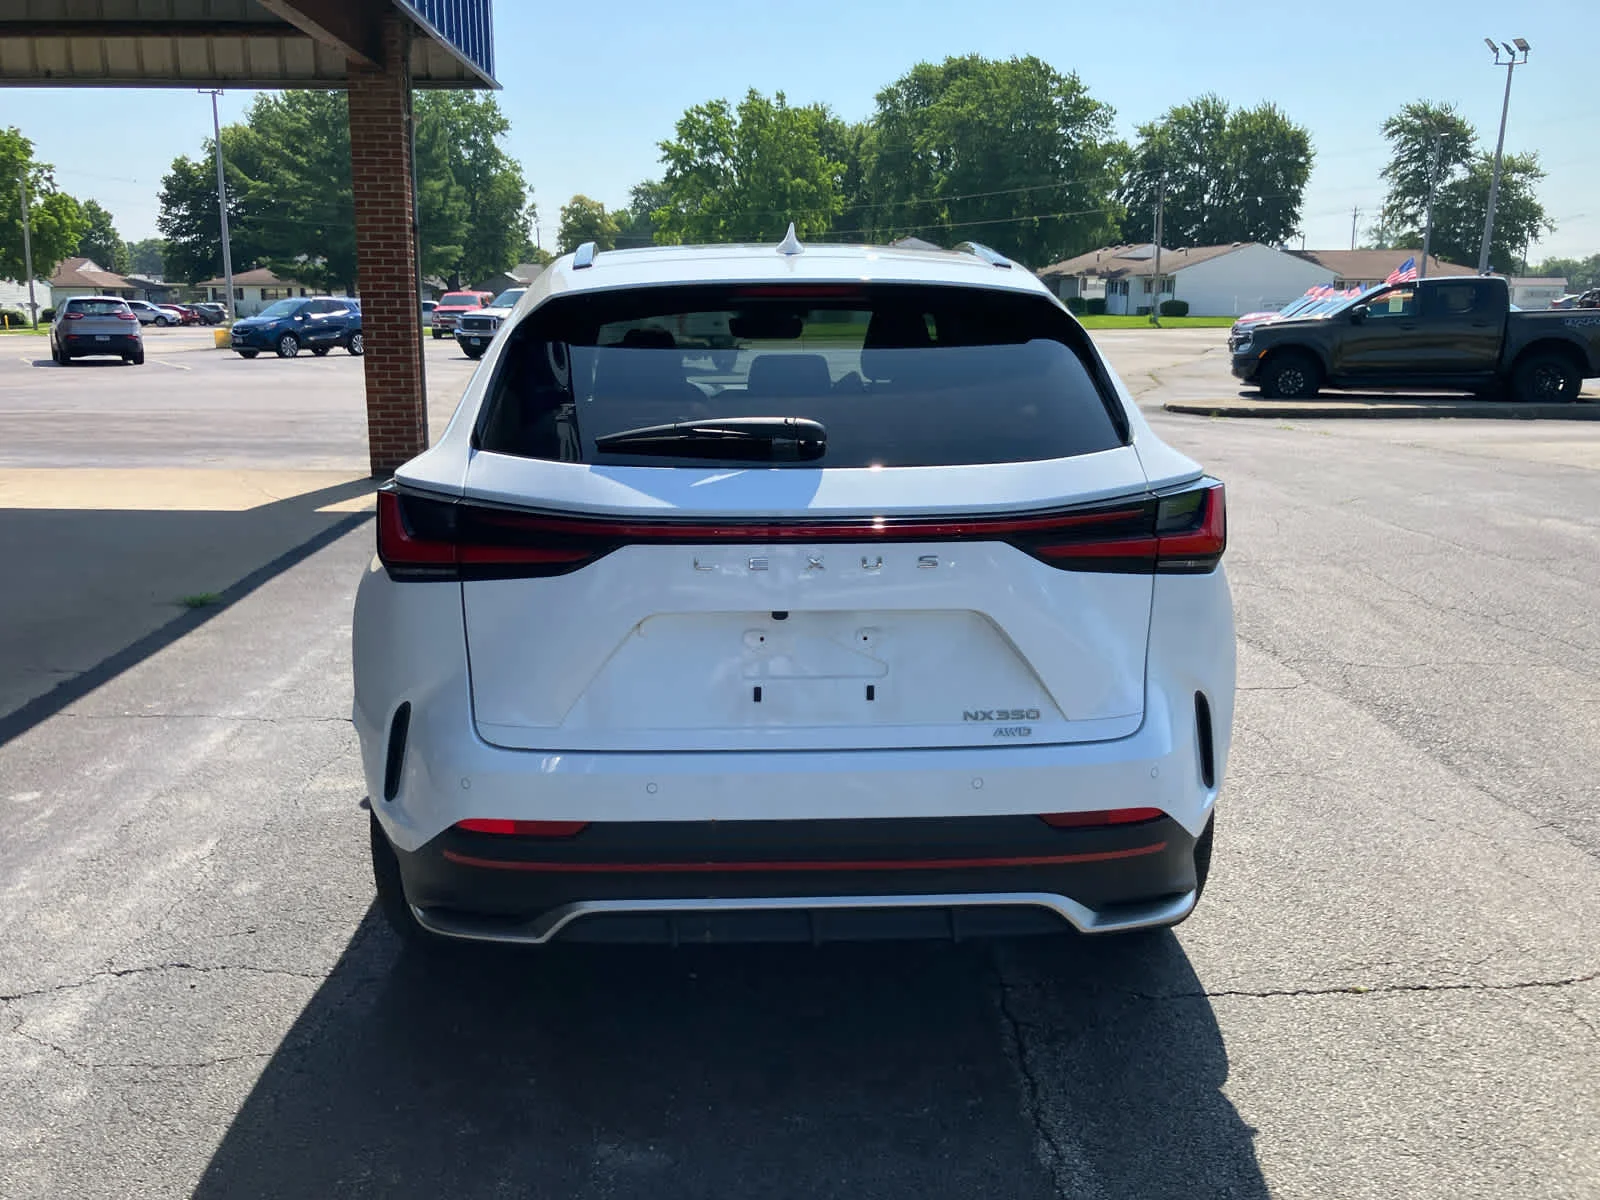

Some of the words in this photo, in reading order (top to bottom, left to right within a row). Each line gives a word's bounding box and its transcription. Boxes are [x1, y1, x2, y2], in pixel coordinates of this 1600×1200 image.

[693, 555, 938, 571] LEXUS
[963, 709, 1040, 721] NX350
[992, 727, 1032, 737] AWD
